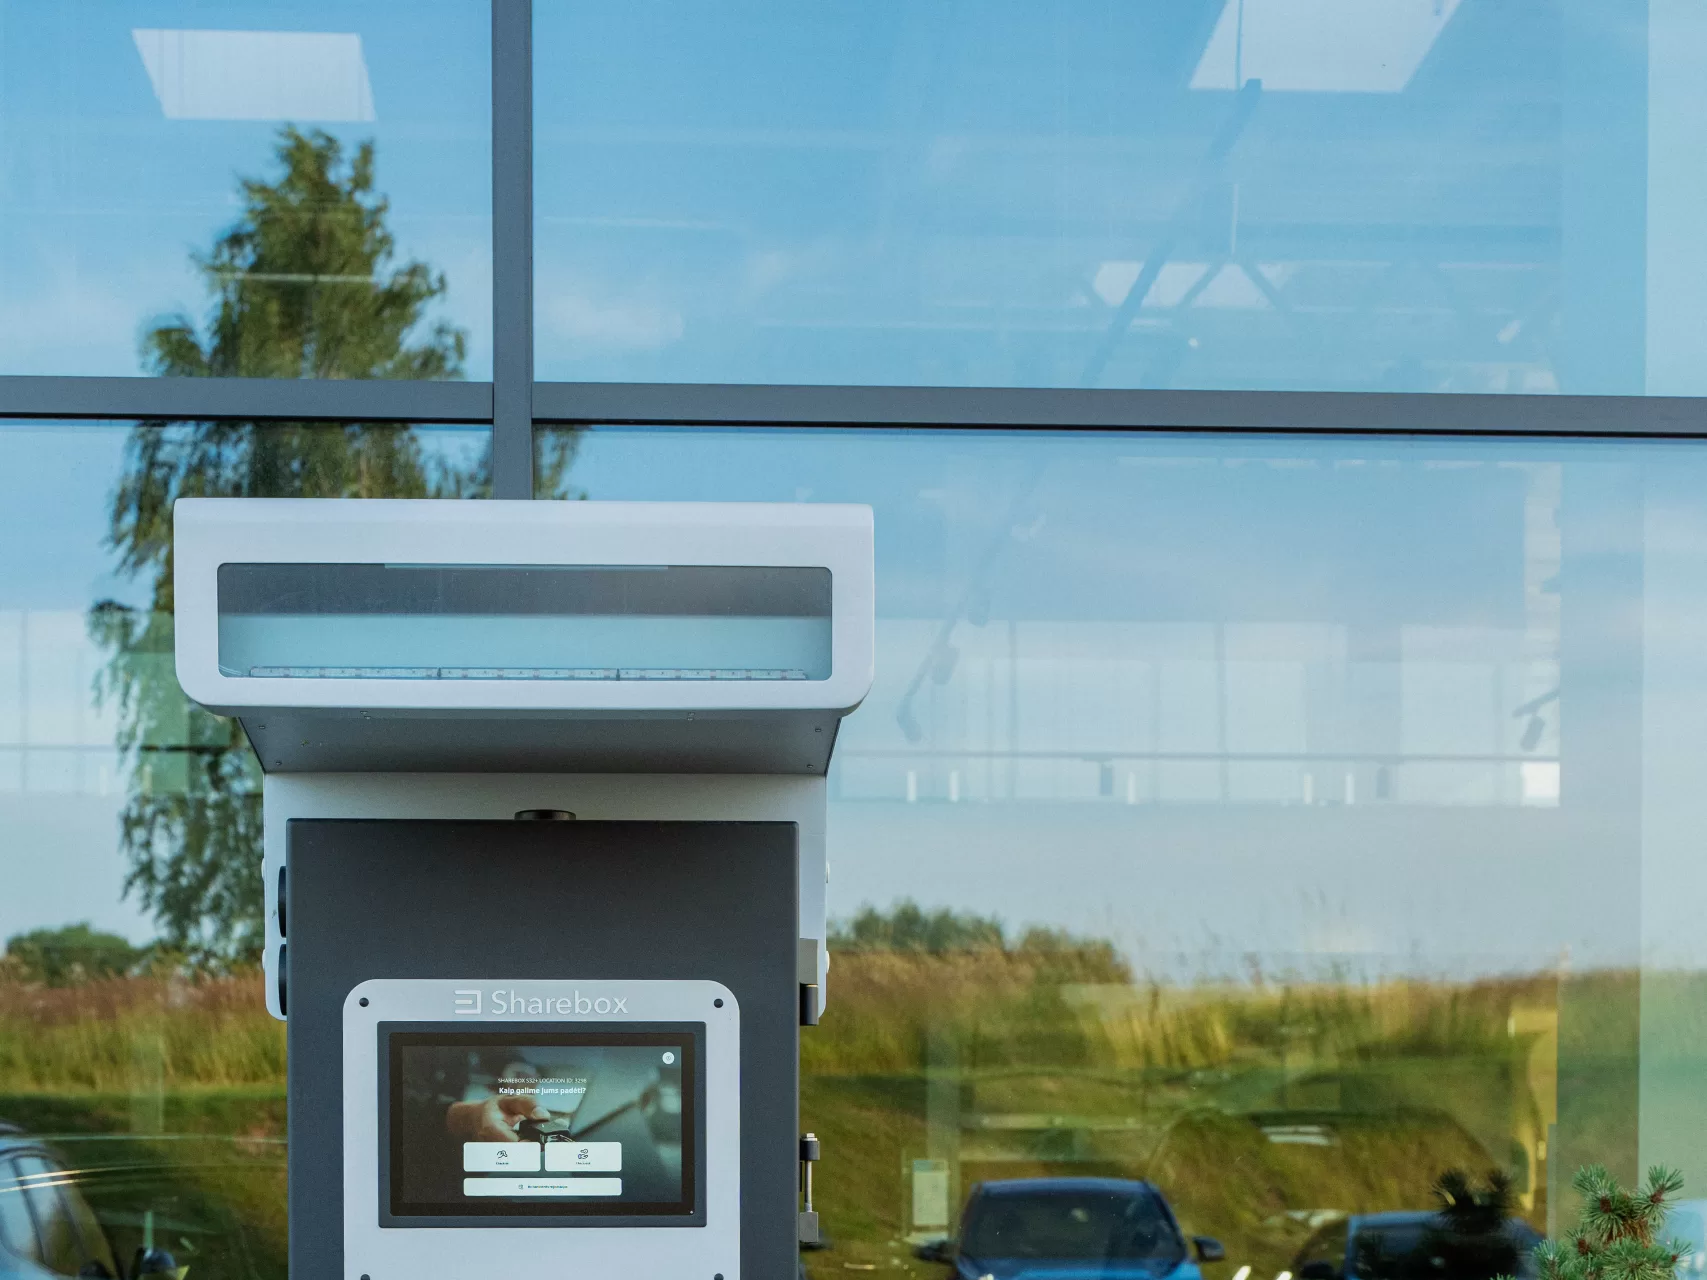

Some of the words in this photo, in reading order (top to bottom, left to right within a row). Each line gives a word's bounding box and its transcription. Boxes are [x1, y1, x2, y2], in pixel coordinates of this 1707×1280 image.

[491, 989, 628, 1015] Sharebox
[498, 1087, 514, 1096] Kaip
[515, 1087, 540, 1096] galime
